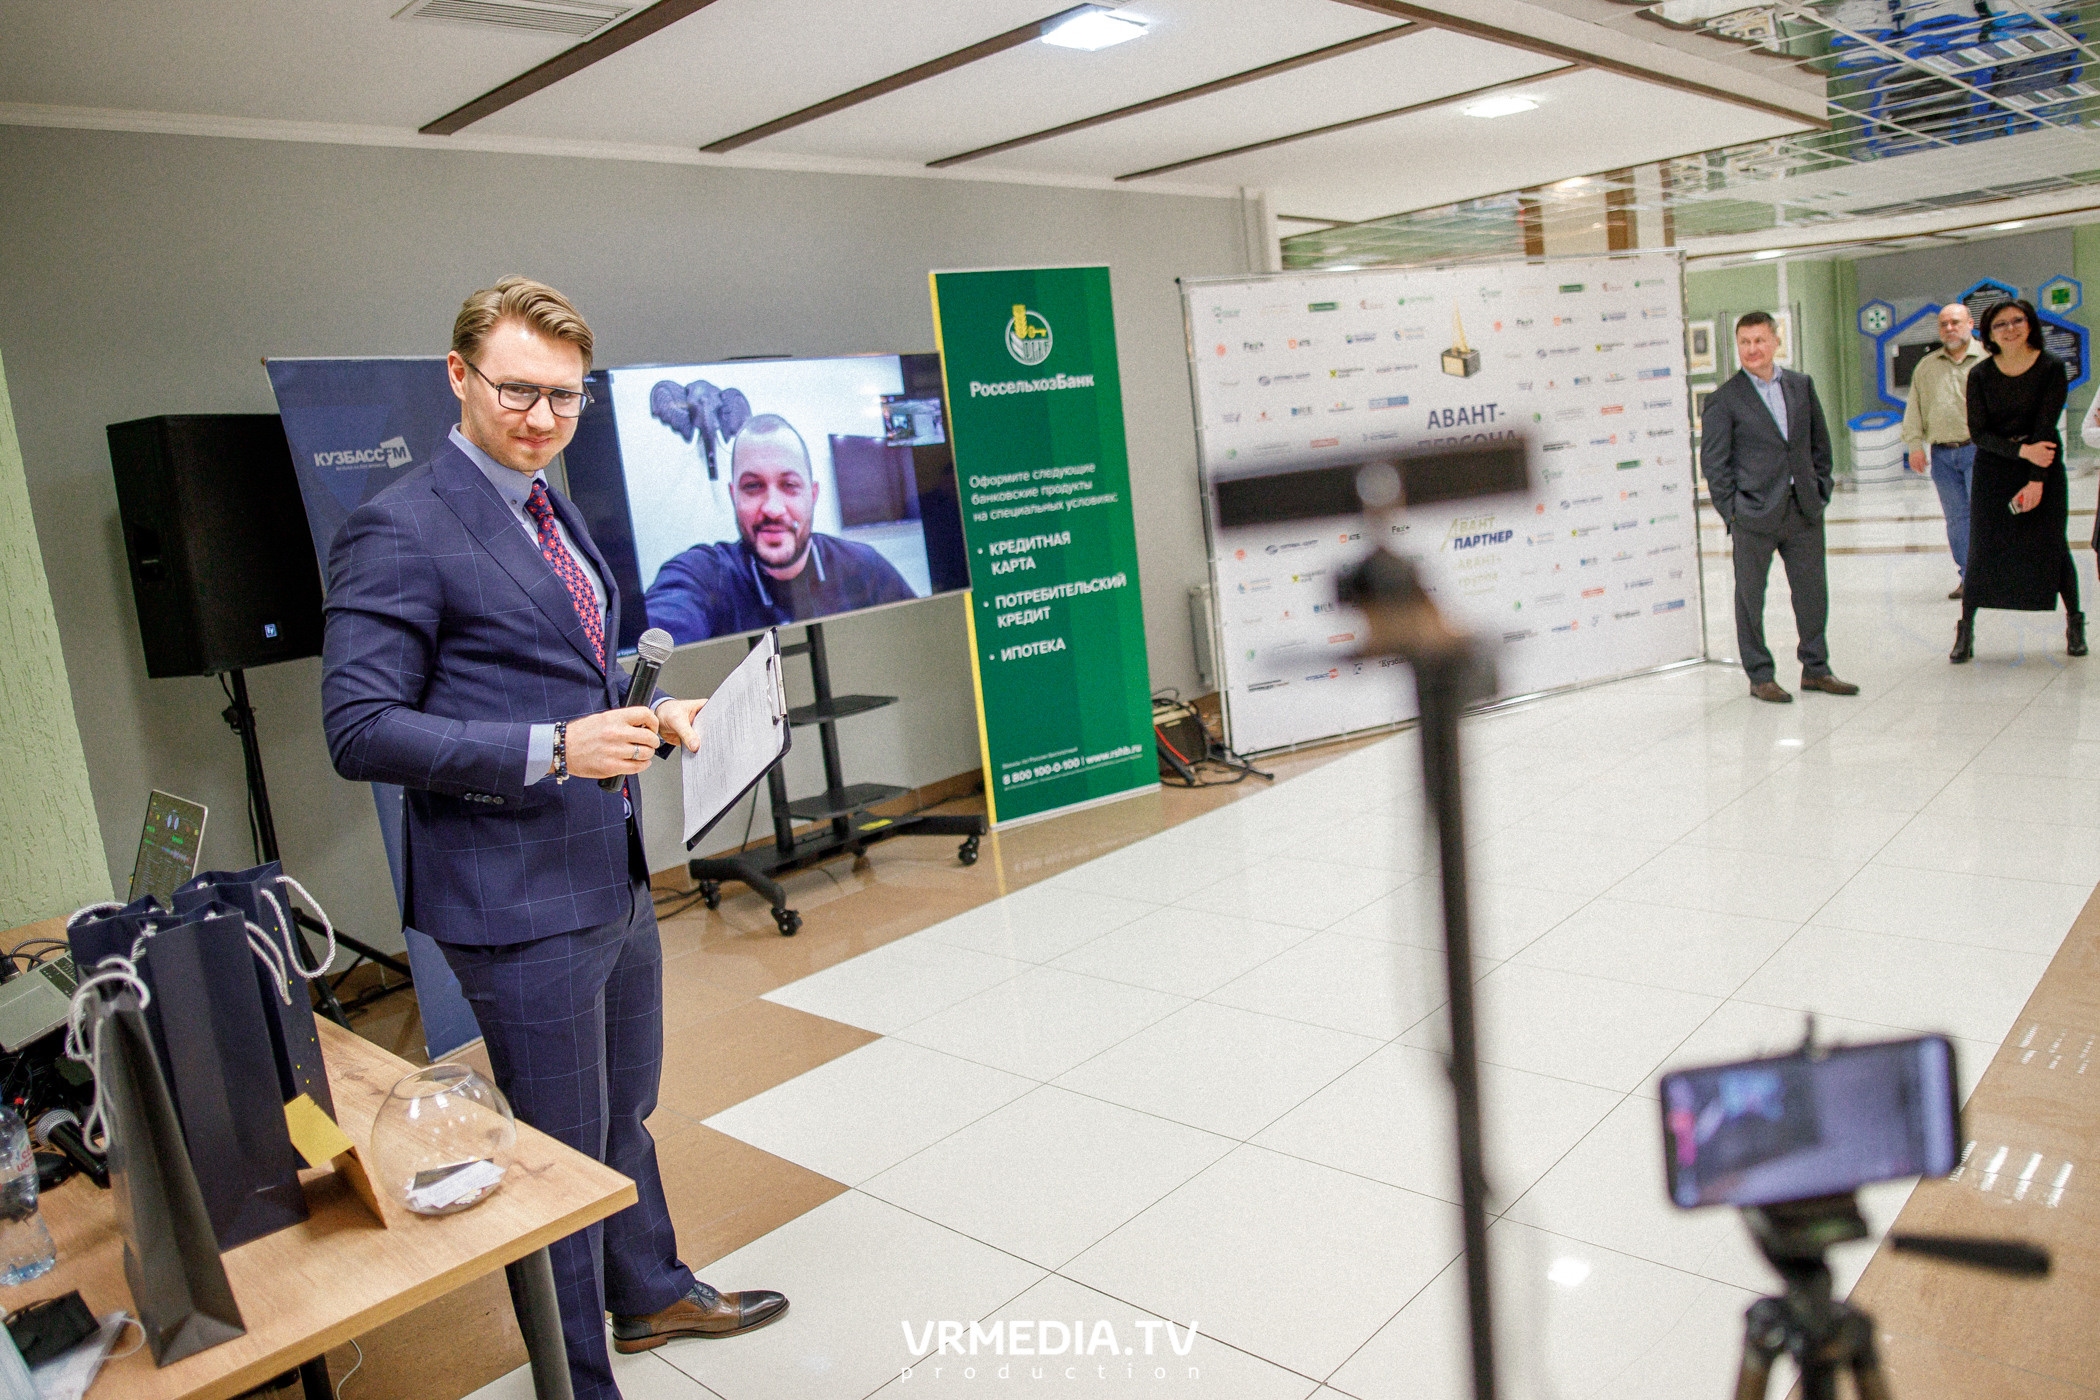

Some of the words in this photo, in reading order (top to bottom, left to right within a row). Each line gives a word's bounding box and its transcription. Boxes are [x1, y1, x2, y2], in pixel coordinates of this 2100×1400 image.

[969, 373, 1095, 398] РоссельхозБанк
[1427, 403, 1505, 430] АВАНТ-
[969, 471, 1030, 489] Оформите
[1032, 463, 1096, 479] следующие
[970, 487, 1039, 505] банковские
[1040, 480, 1093, 497] продукты
[973, 511, 988, 522] на
[990, 501, 1064, 520] специальных
[989, 531, 1071, 556] КРЕДИТНАЯ
[1454, 529, 1513, 550] ПАРТНЕР
[991, 556, 1036, 575] КАРТА
[995, 572, 1127, 609] ПОТРЕБИТЕЛЬСКИЙ
[997, 606, 1051, 628] КРЕДИТ
[1000, 637, 1066, 662] ИПОТЕКА
[1012, 769, 1032, 783] 800
[1033, 757, 1080, 778] 100-0-100
